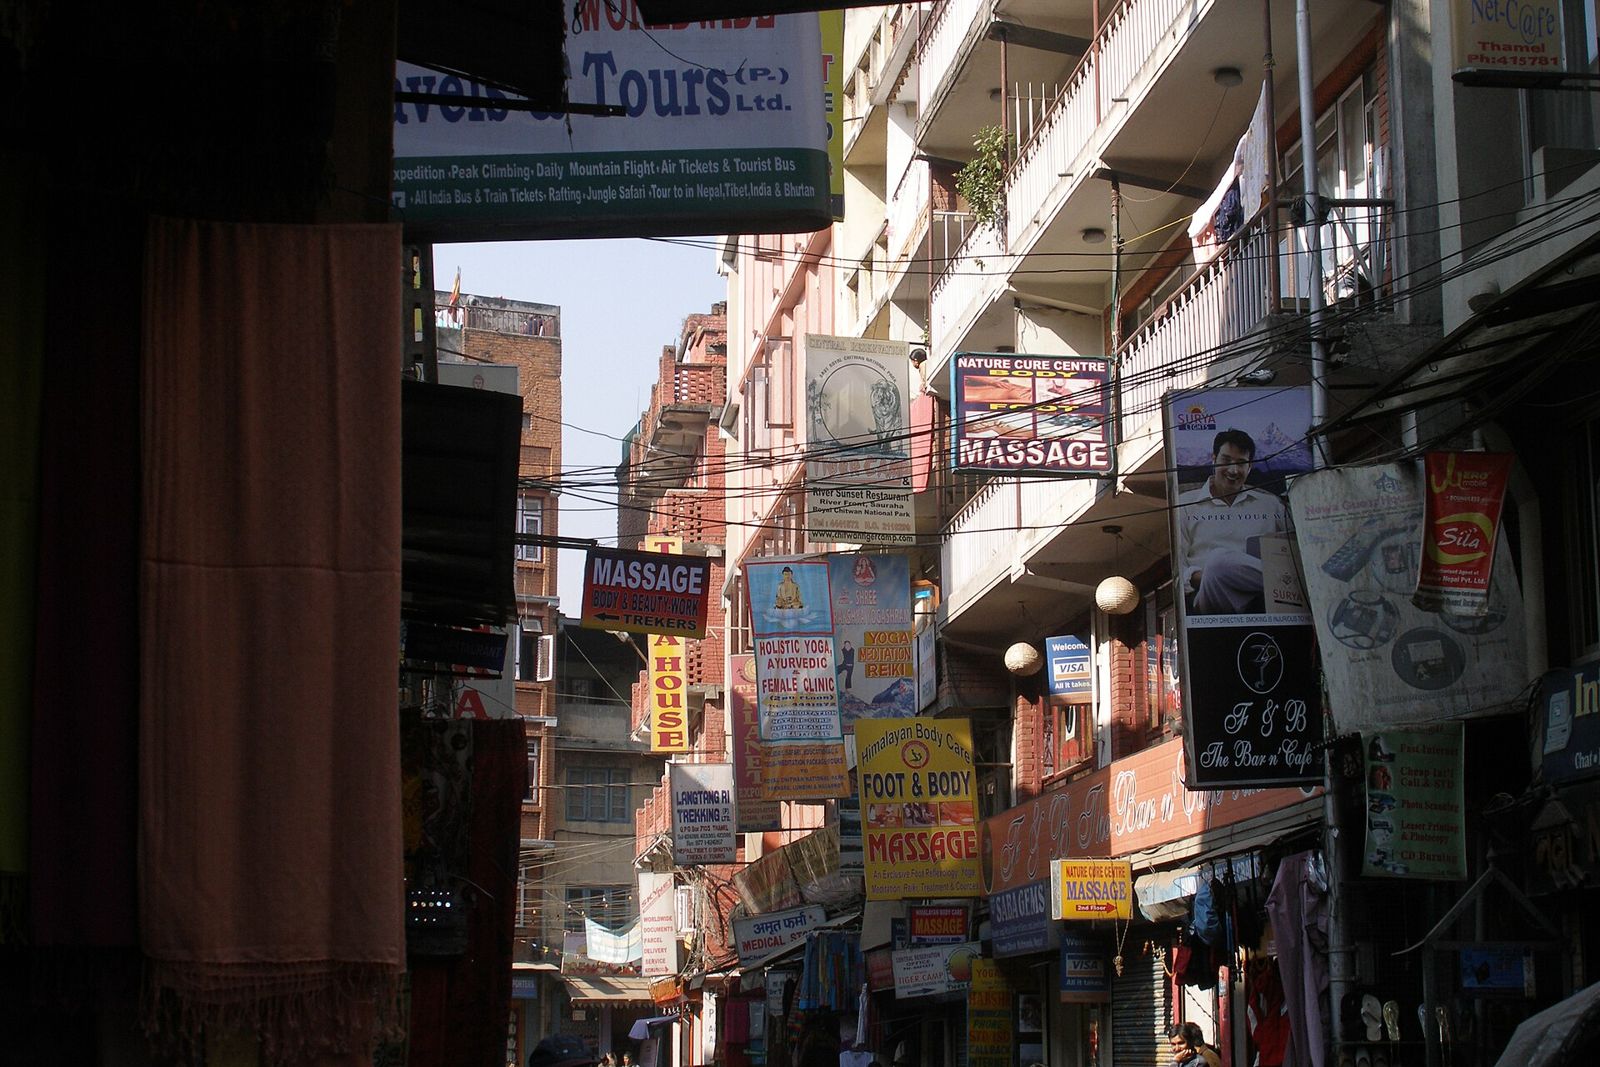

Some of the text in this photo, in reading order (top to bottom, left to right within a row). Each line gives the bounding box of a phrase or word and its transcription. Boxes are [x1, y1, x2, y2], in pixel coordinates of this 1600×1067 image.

[1478, 41, 1545, 53] Thamel
[583, 51, 731, 118] Tours
[736, 94, 791, 111] Ltd.
[451, 164, 479, 180] Peak
[482, 163, 530, 181] Climbing
[537, 163, 564, 180] Daily
[570, 159, 620, 177] Mountain
[624, 160, 655, 178] Flight
[661, 159, 676, 175] Air
[680, 158, 719, 174] Tickets
[723, 158, 731, 173] &
[734, 157, 770, 173] Tourist
[775, 156, 797, 172] Bus
[415, 182, 815, 205] All India Bus & Train Tickets Rafting Jungle Safari Tour to in & Bhutan
[958, 358, 1106, 372] NATURE CURE CENTRE
[989, 369, 1079, 378] BODY
[1177, 413, 1216, 424] SURYA
[960, 438, 1109, 467] MASSAGE
[902, 477, 911, 487] &
[836, 489, 863, 499] Sunset
[866, 490, 910, 502] Restaurant
[820, 498, 904, 509] River Front, Sauraha
[834, 507, 862, 515] Chitwan
[864, 509, 893, 517] National
[593, 557, 703, 595] MASSAGE
[593, 589, 619, 609] BODY
[622, 592, 629, 609] &
[1273, 589, 1303, 602] SURYA
[624, 613, 697, 630] TREKERS
[868, 631, 911, 645] YOGA
[760, 639, 833, 657] HOLISTIC YOGA,
[859, 646, 911, 661] MEDITATION
[767, 657, 828, 670] AYURVEDIC
[868, 663, 906, 677] REIKI
[1060, 663, 1085, 673] VISA
[762, 677, 835, 694] FEMALE CLINIC
[1055, 682, 1065, 690] All
[1071, 680, 1091, 689] takes.
[653, 655, 684, 748] HOUSE
[1574, 671, 1600, 718] In
[1224, 699, 1307, 737] F & B
[861, 722, 971, 768] Himalayan Body Care
[1400, 744, 1459, 757] Fast Internet
[1200, 741, 1230, 768] The
[1234, 739, 1267, 768] Bar
[1575, 751, 1593, 769] Chat
[1400, 766, 1429, 778] Cheap
[863, 770, 971, 799] FOOT & BODY
[1400, 778, 1420, 788] Call
[676, 789, 731, 805] LANGTANG RI
[1113, 770, 1156, 837] Bar
[1401, 799, 1423, 809] Photo
[677, 808, 720, 824] TREKKING
[868, 830, 978, 866] MASSAGE
[1400, 850, 1416, 860] CD
[1066, 865, 1126, 879] NATURE CURE CENTRE
[1066, 881, 1127, 900] MASSAGE
[995, 884, 1046, 923] SABA GEMS
[643, 915, 673, 923] WORLDWIDE
[915, 918, 963, 935] MASSAGE
[742, 935, 785, 952] MEDICAL
[1073, 960, 1098, 970] VISA
[899, 975, 922, 985] TIGER
[922, 971, 944, 982] CAMP
[976, 968, 1001, 979] YOGA
